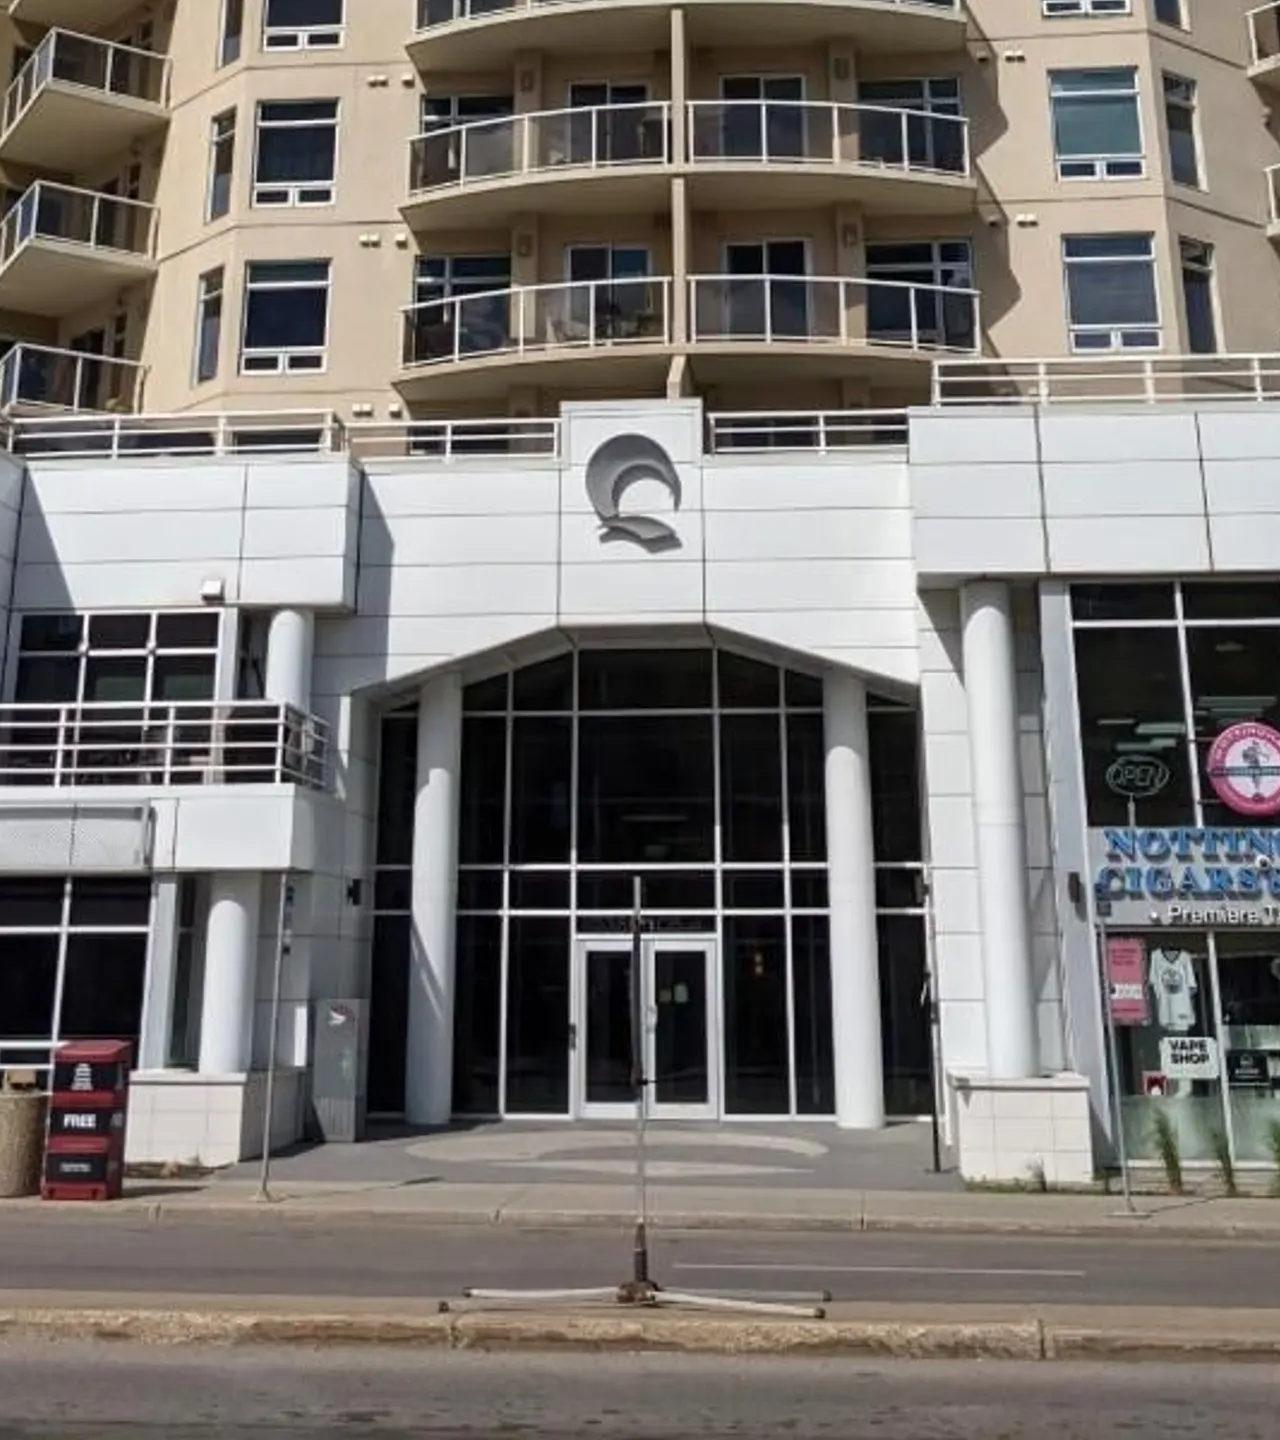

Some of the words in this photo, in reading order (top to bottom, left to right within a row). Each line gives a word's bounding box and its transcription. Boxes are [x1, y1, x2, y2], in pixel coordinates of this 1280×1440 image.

[1097, 866, 1261, 897] CIGARS
[1168, 905, 1261, 924] Premiere
[1169, 1040, 1208, 1052] VAPE
[1170, 1053, 1210, 1065] SHOP
[63, 1113, 97, 1128] FREE
